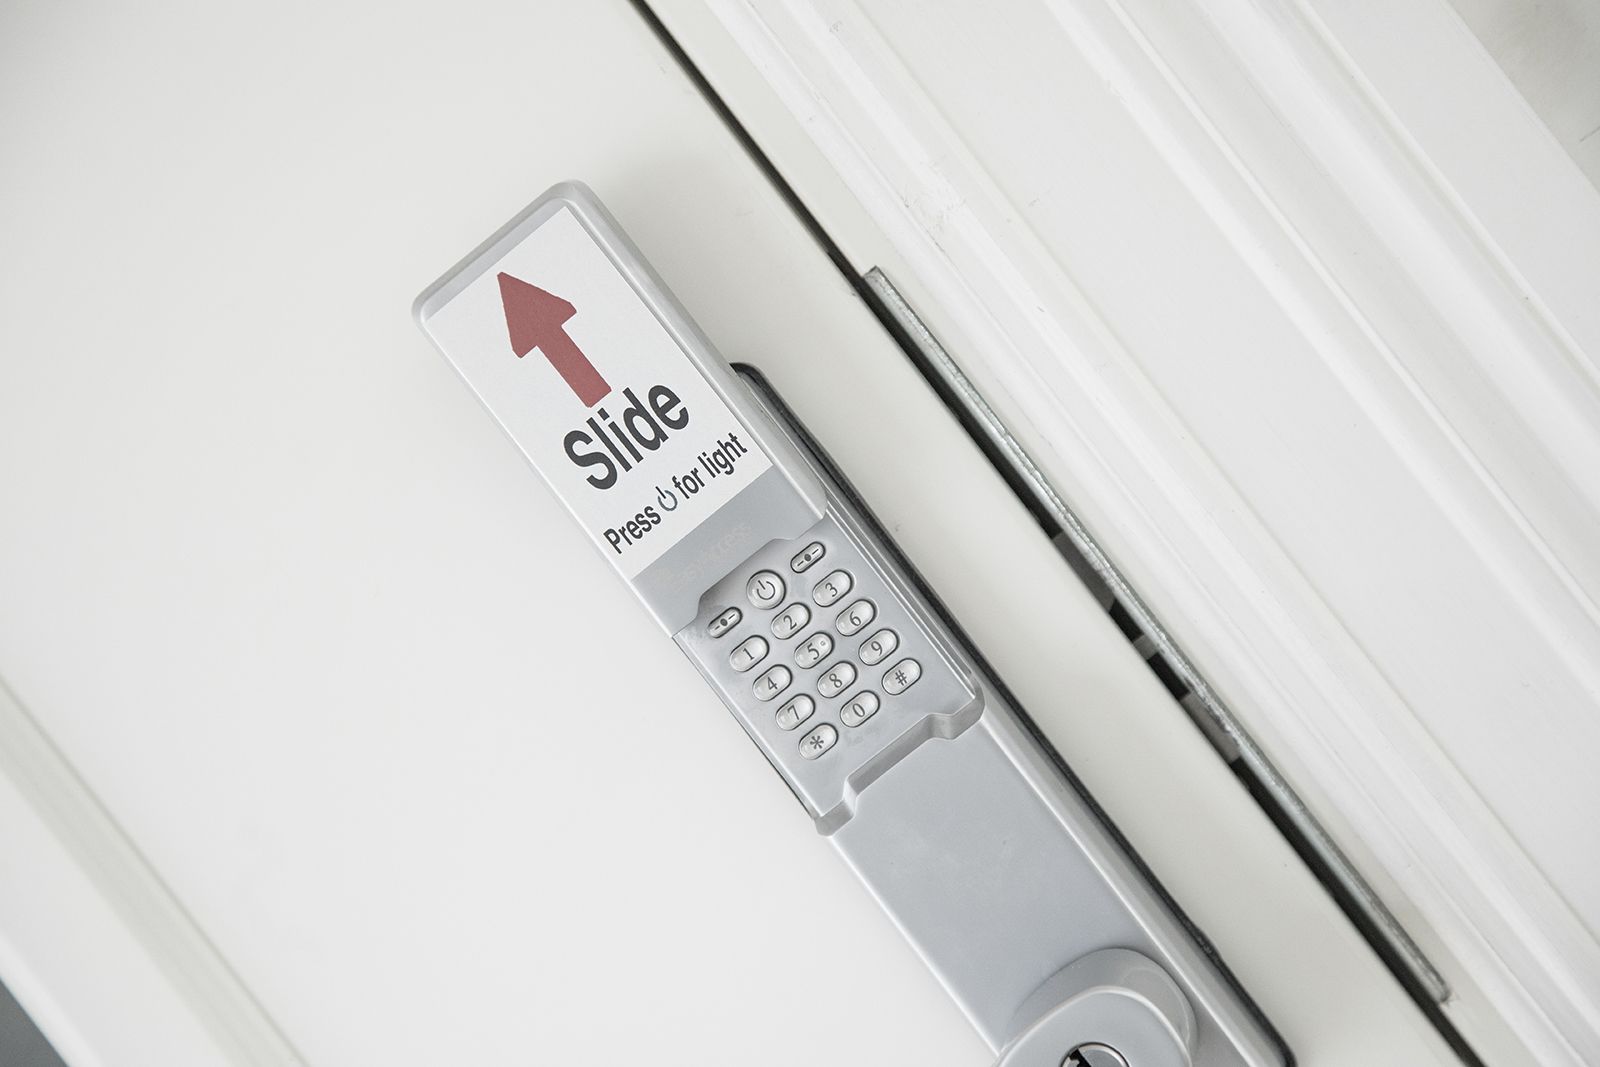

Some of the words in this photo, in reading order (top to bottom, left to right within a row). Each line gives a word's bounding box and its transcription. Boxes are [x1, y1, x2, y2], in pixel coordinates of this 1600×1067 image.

[563, 384, 689, 490] Slide
[603, 505, 662, 555] Press
[671, 467, 705, 500] for
[697, 432, 748, 479] light
[742, 647, 755, 660] 1
[783, 614, 797, 630] 2
[824, 582, 838, 598] 3
[766, 676, 778, 691] 4
[806, 643, 820, 661] 5
[848, 611, 862, 627] 6
[787, 705, 802, 720] 7
[829, 673, 842, 688] 8
[870, 640, 883, 656] 9
[852, 702, 866, 718] 0
[894, 670, 908, 686] #
